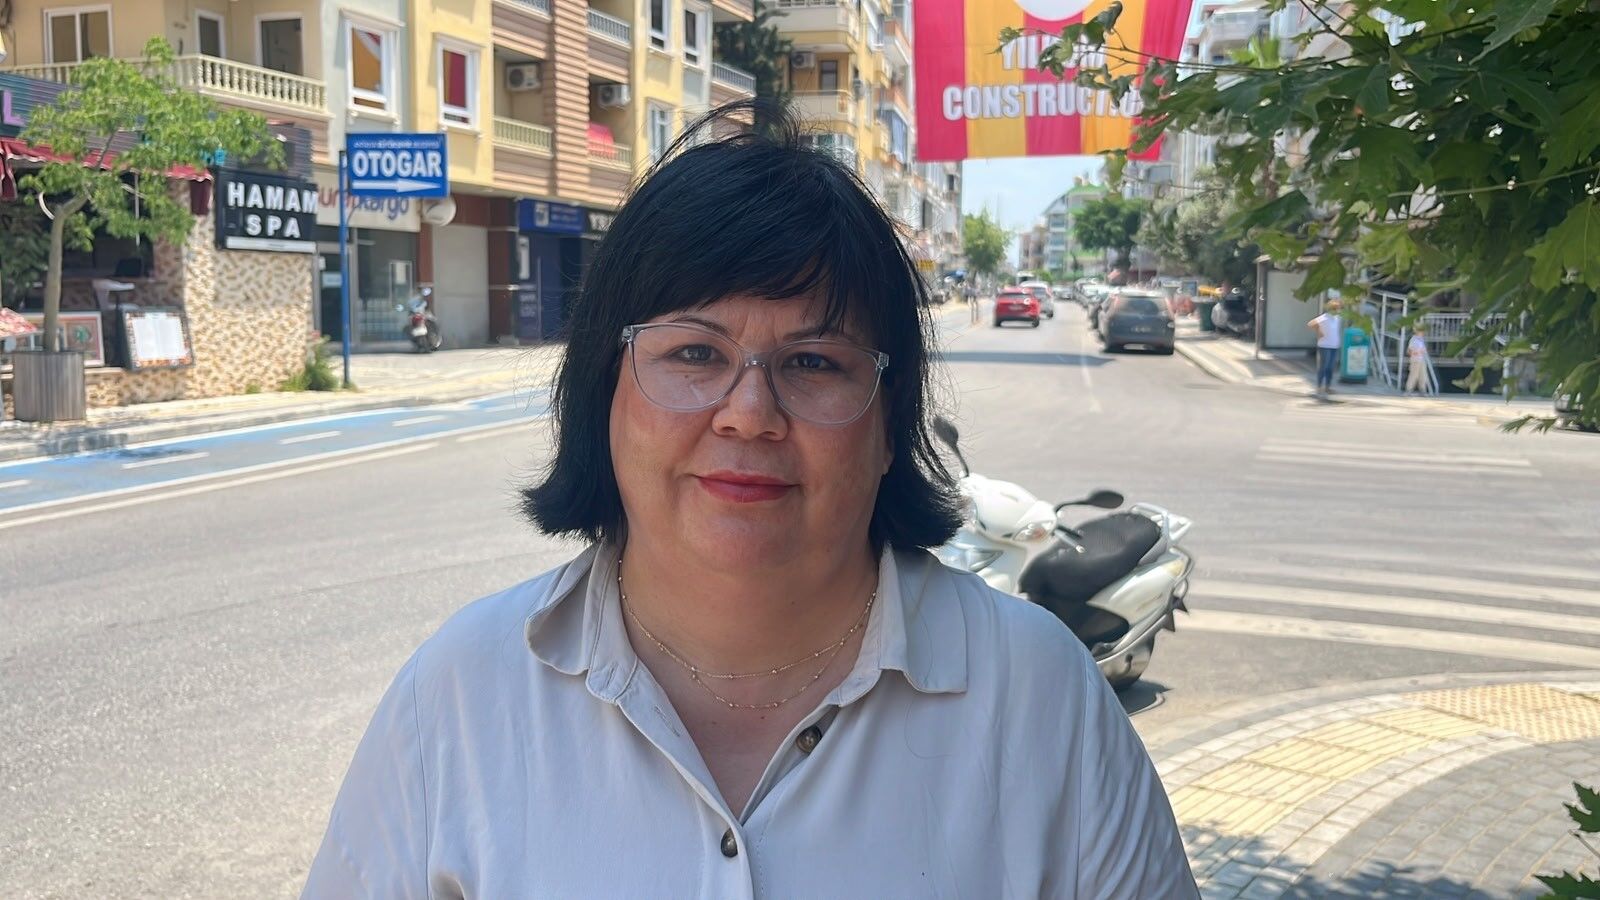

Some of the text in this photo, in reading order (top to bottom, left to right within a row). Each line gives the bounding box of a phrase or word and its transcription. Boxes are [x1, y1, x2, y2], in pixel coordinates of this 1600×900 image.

[942, 84, 1145, 120] CONSTRUCTO
[352, 150, 443, 177] OTOGAR
[227, 181, 318, 214] HAMAM
[246, 214, 301, 238] SPA
